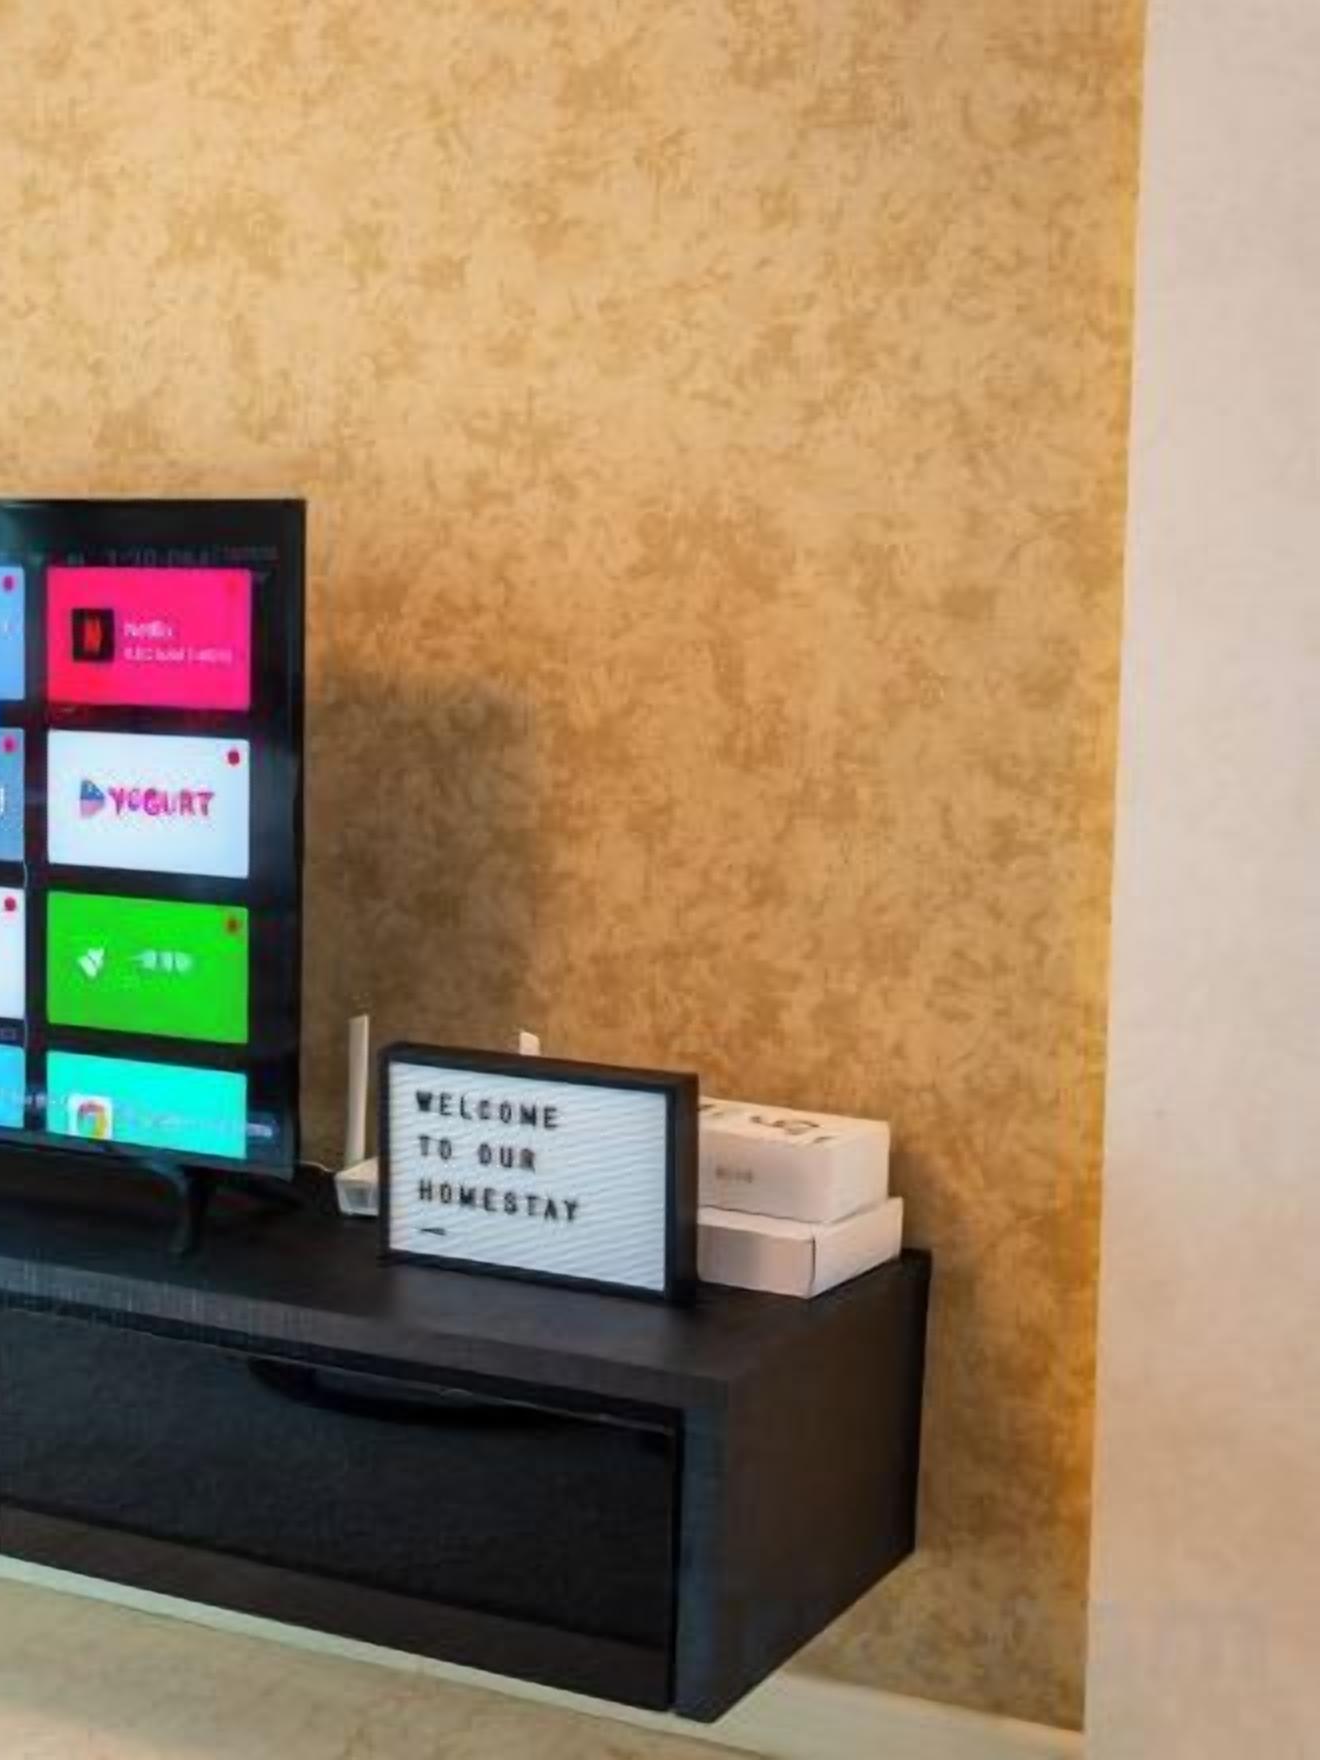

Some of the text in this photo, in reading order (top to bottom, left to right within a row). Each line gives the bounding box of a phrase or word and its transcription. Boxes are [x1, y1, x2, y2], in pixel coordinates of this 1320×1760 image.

[107, 787, 215, 817] YOGURT
[415, 1089, 559, 1131] WELCOME
[418, 1134, 537, 1174] TO OUR
[417, 1178, 579, 1223] HOMESTAY
